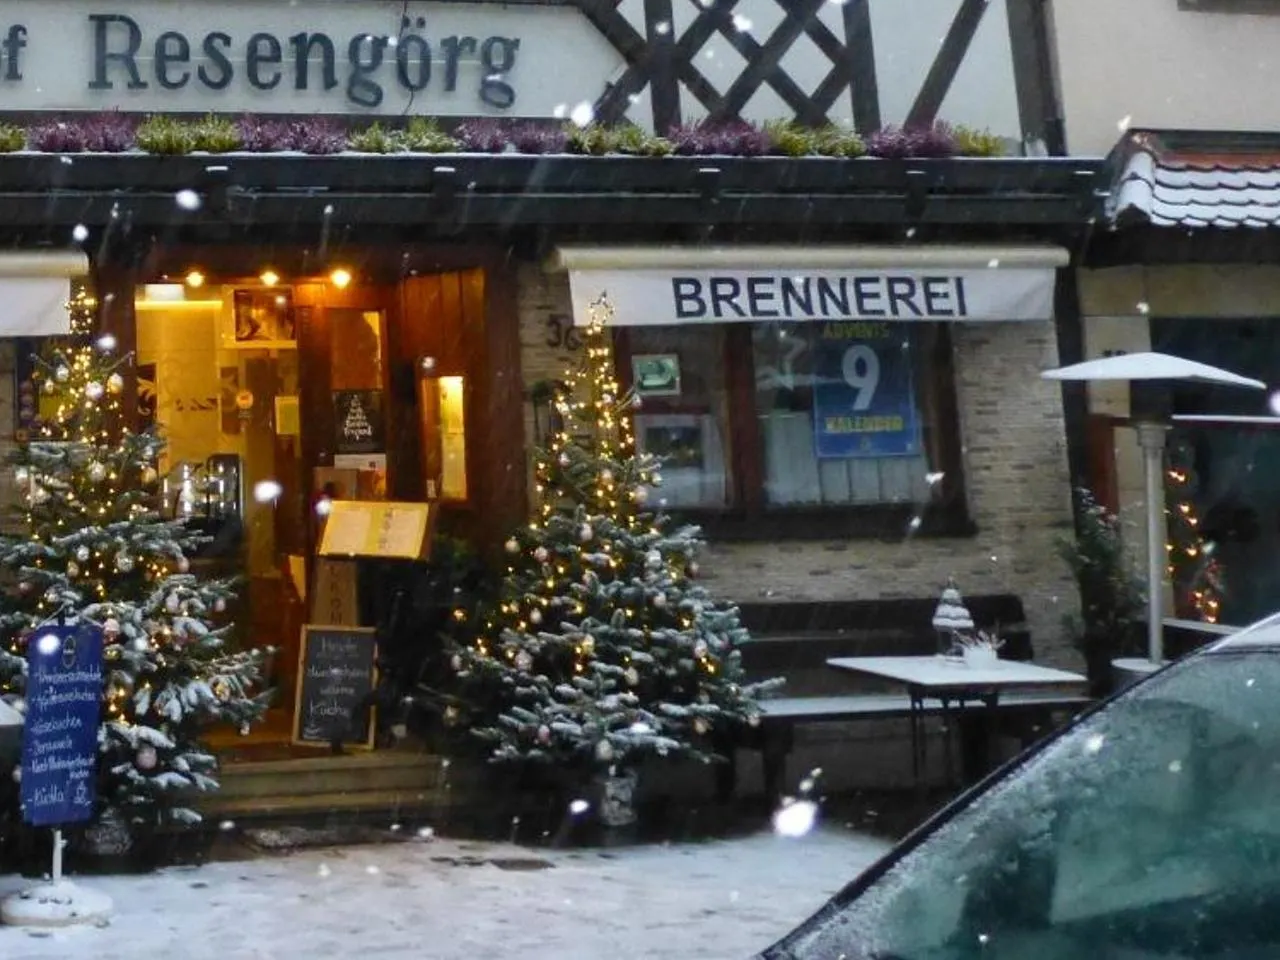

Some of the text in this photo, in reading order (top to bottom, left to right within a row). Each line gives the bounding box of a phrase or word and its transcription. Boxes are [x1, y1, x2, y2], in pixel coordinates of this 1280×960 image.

[87, 13, 520, 110] Resengörg
[671, 276, 968, 319] BRENNEREI
[841, 343, 880, 411] 9
